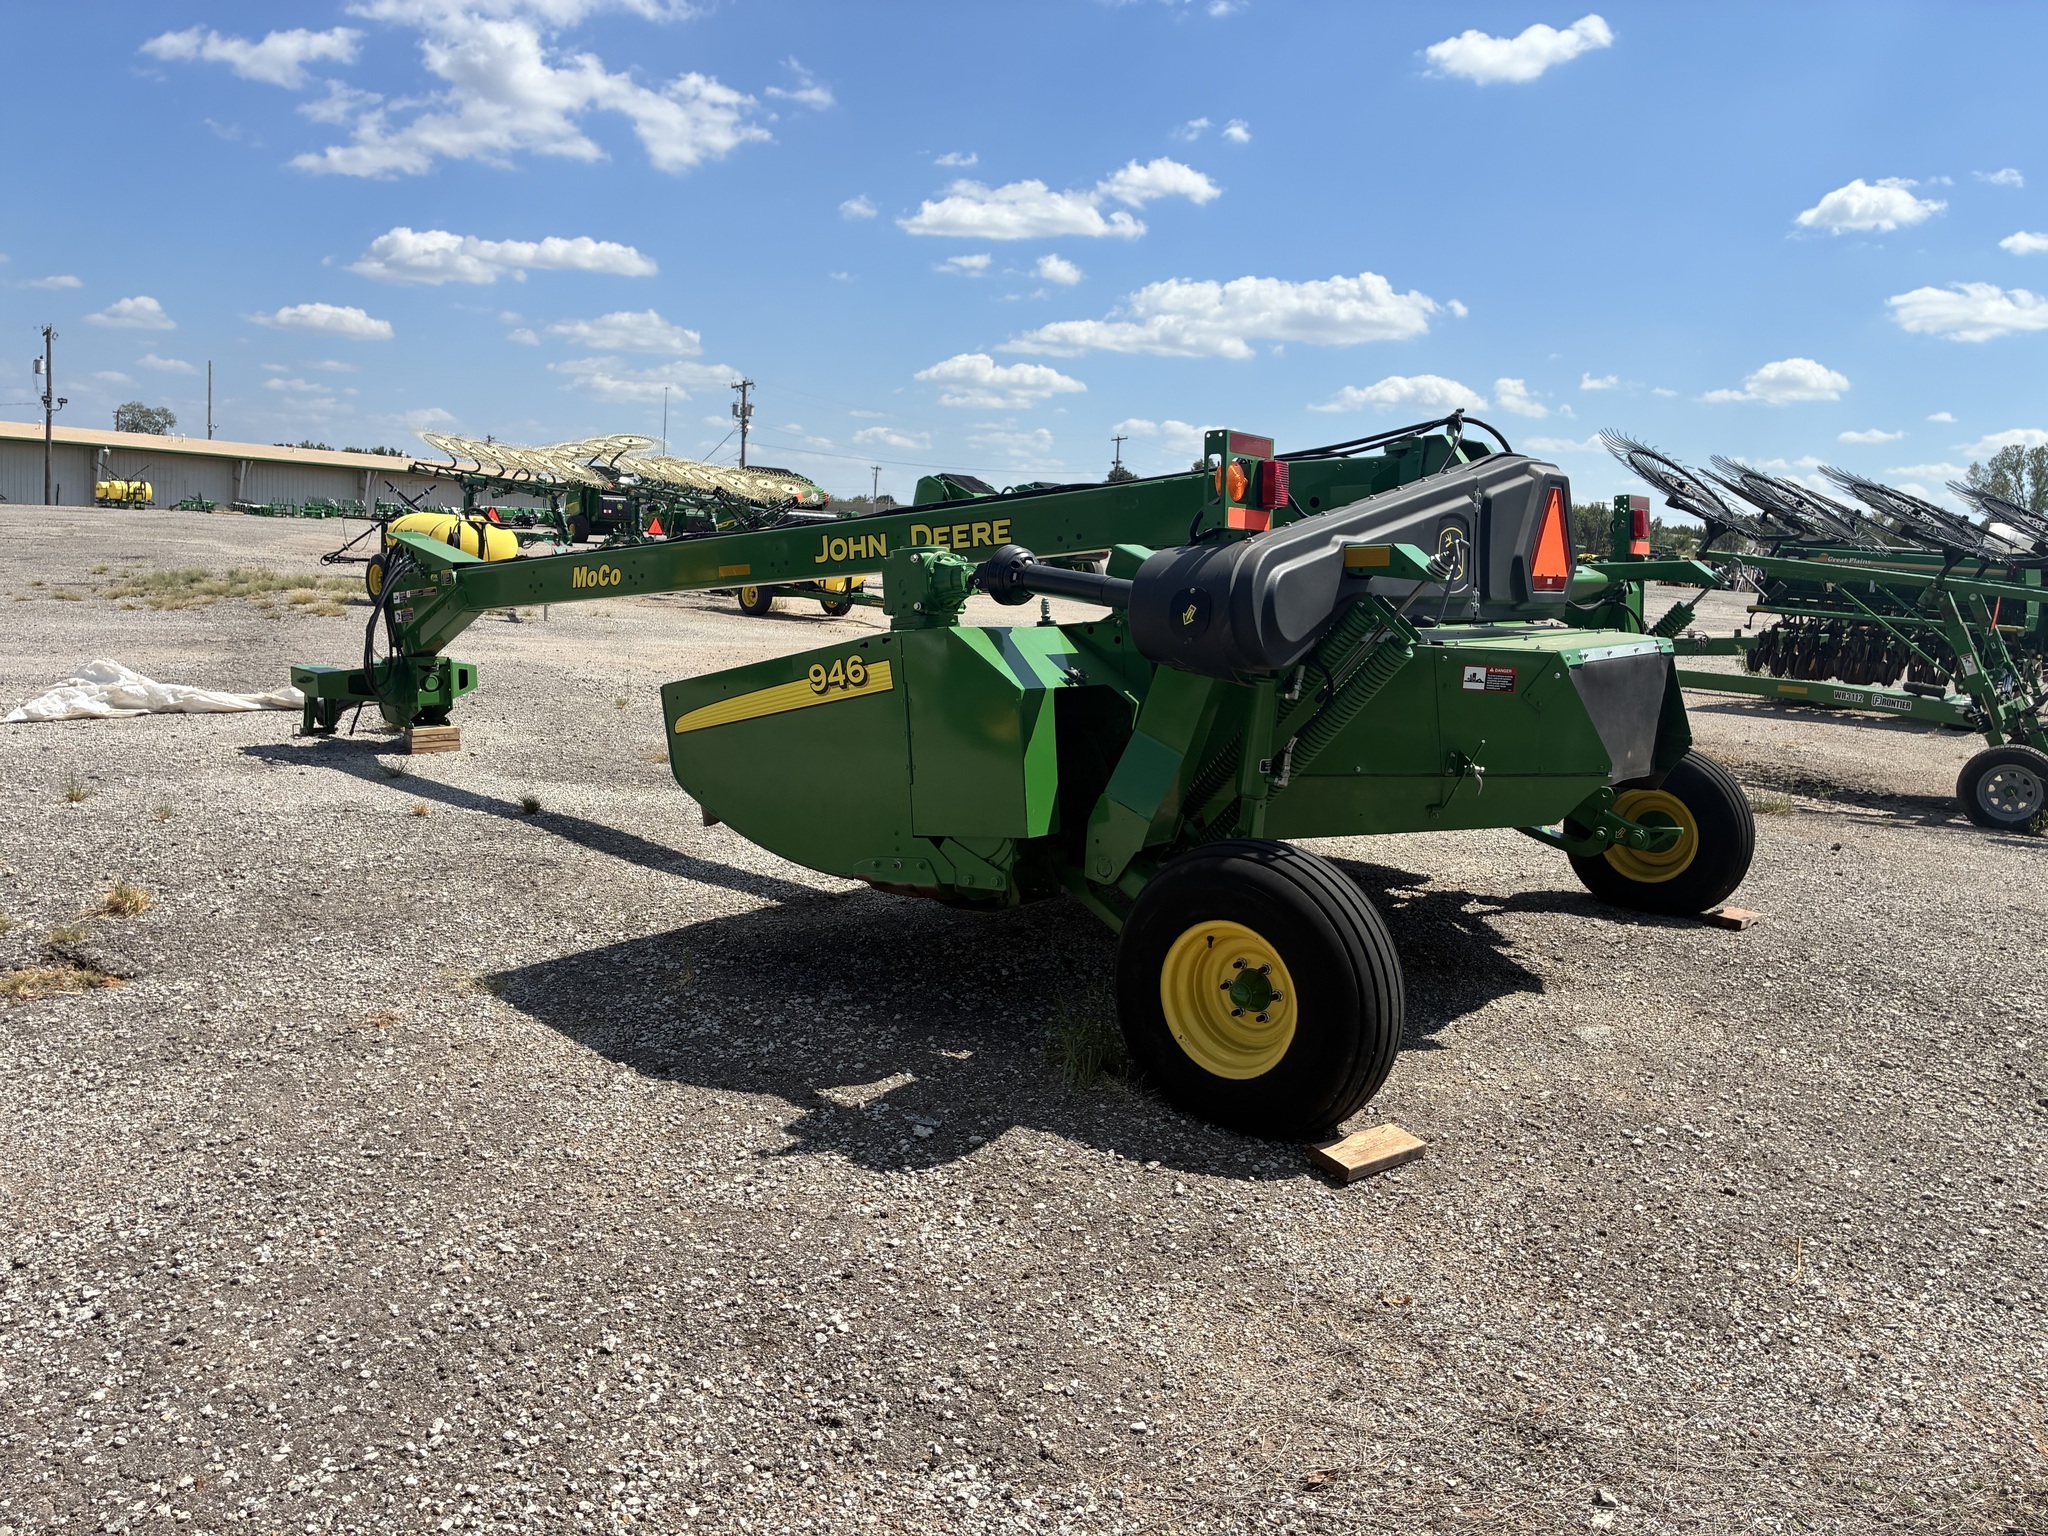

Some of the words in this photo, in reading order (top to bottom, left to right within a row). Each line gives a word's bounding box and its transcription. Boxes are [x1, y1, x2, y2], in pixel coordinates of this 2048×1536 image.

[814, 533, 888, 564] JOHN
[910, 518, 1013, 550] DEERE
[1849, 557, 1871, 565] Plains
[572, 563, 622, 589] MoCo
[808, 654, 867, 694] 946
[1833, 690, 1864, 703] WR3112
[1871, 693, 1912, 711] FRONTIER
